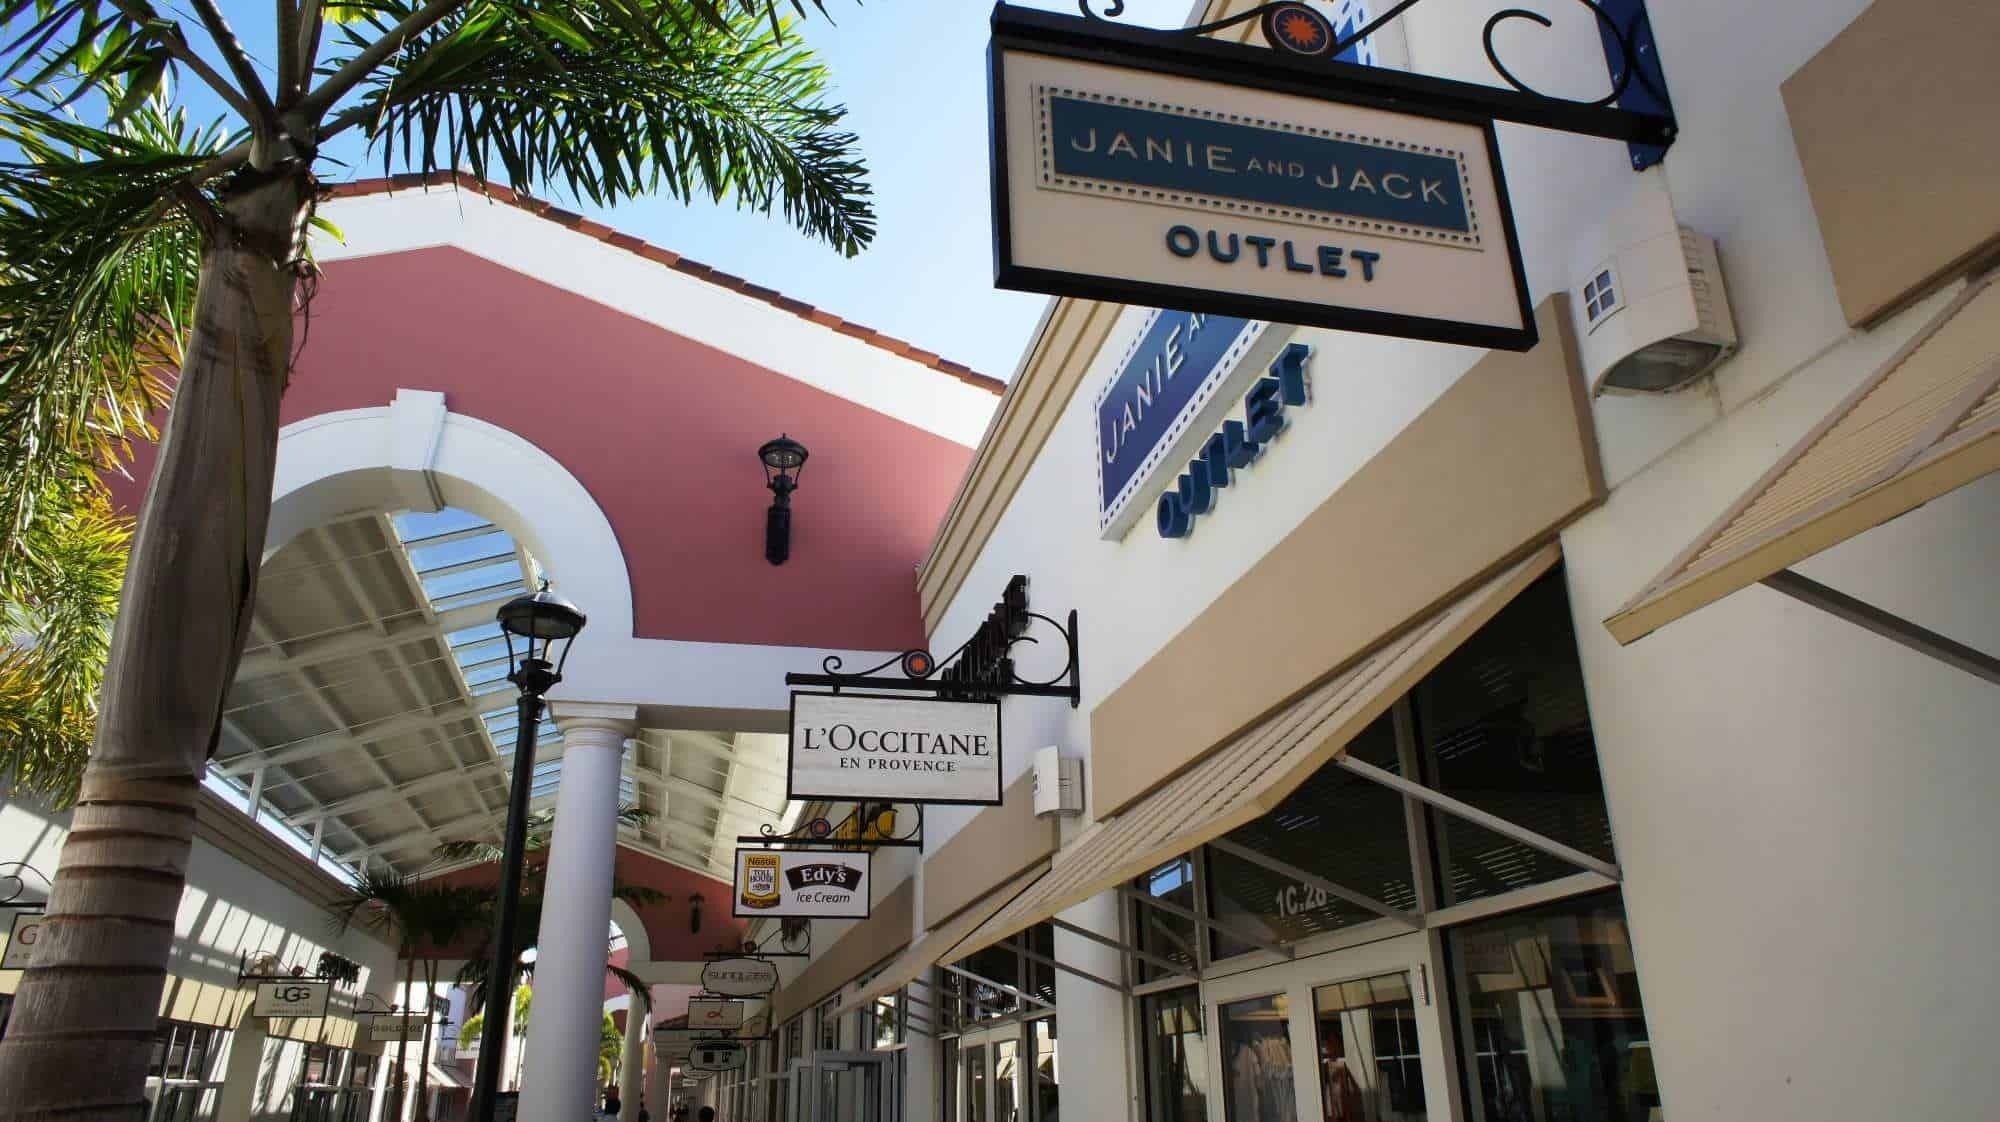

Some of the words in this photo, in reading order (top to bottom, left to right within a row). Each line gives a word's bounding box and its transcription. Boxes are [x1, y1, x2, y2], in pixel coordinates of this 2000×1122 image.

[1071, 127, 1236, 173] JANIE
[1247, 157, 1304, 178] AND
[1315, 164, 1449, 206] JACK
[1165, 224, 1381, 282] OUTLET
[1106, 324, 1184, 463] JANIE
[1156, 342, 1309, 539] OUTLET
[839, 756, 861, 769] EN
[867, 758, 957, 773] PROVENCE
[800, 866, 847, 884] Edy's
[796, 892, 812, 903] Ice
[814, 892, 850, 904] Cream
[274, 986, 311, 1002] UGG
